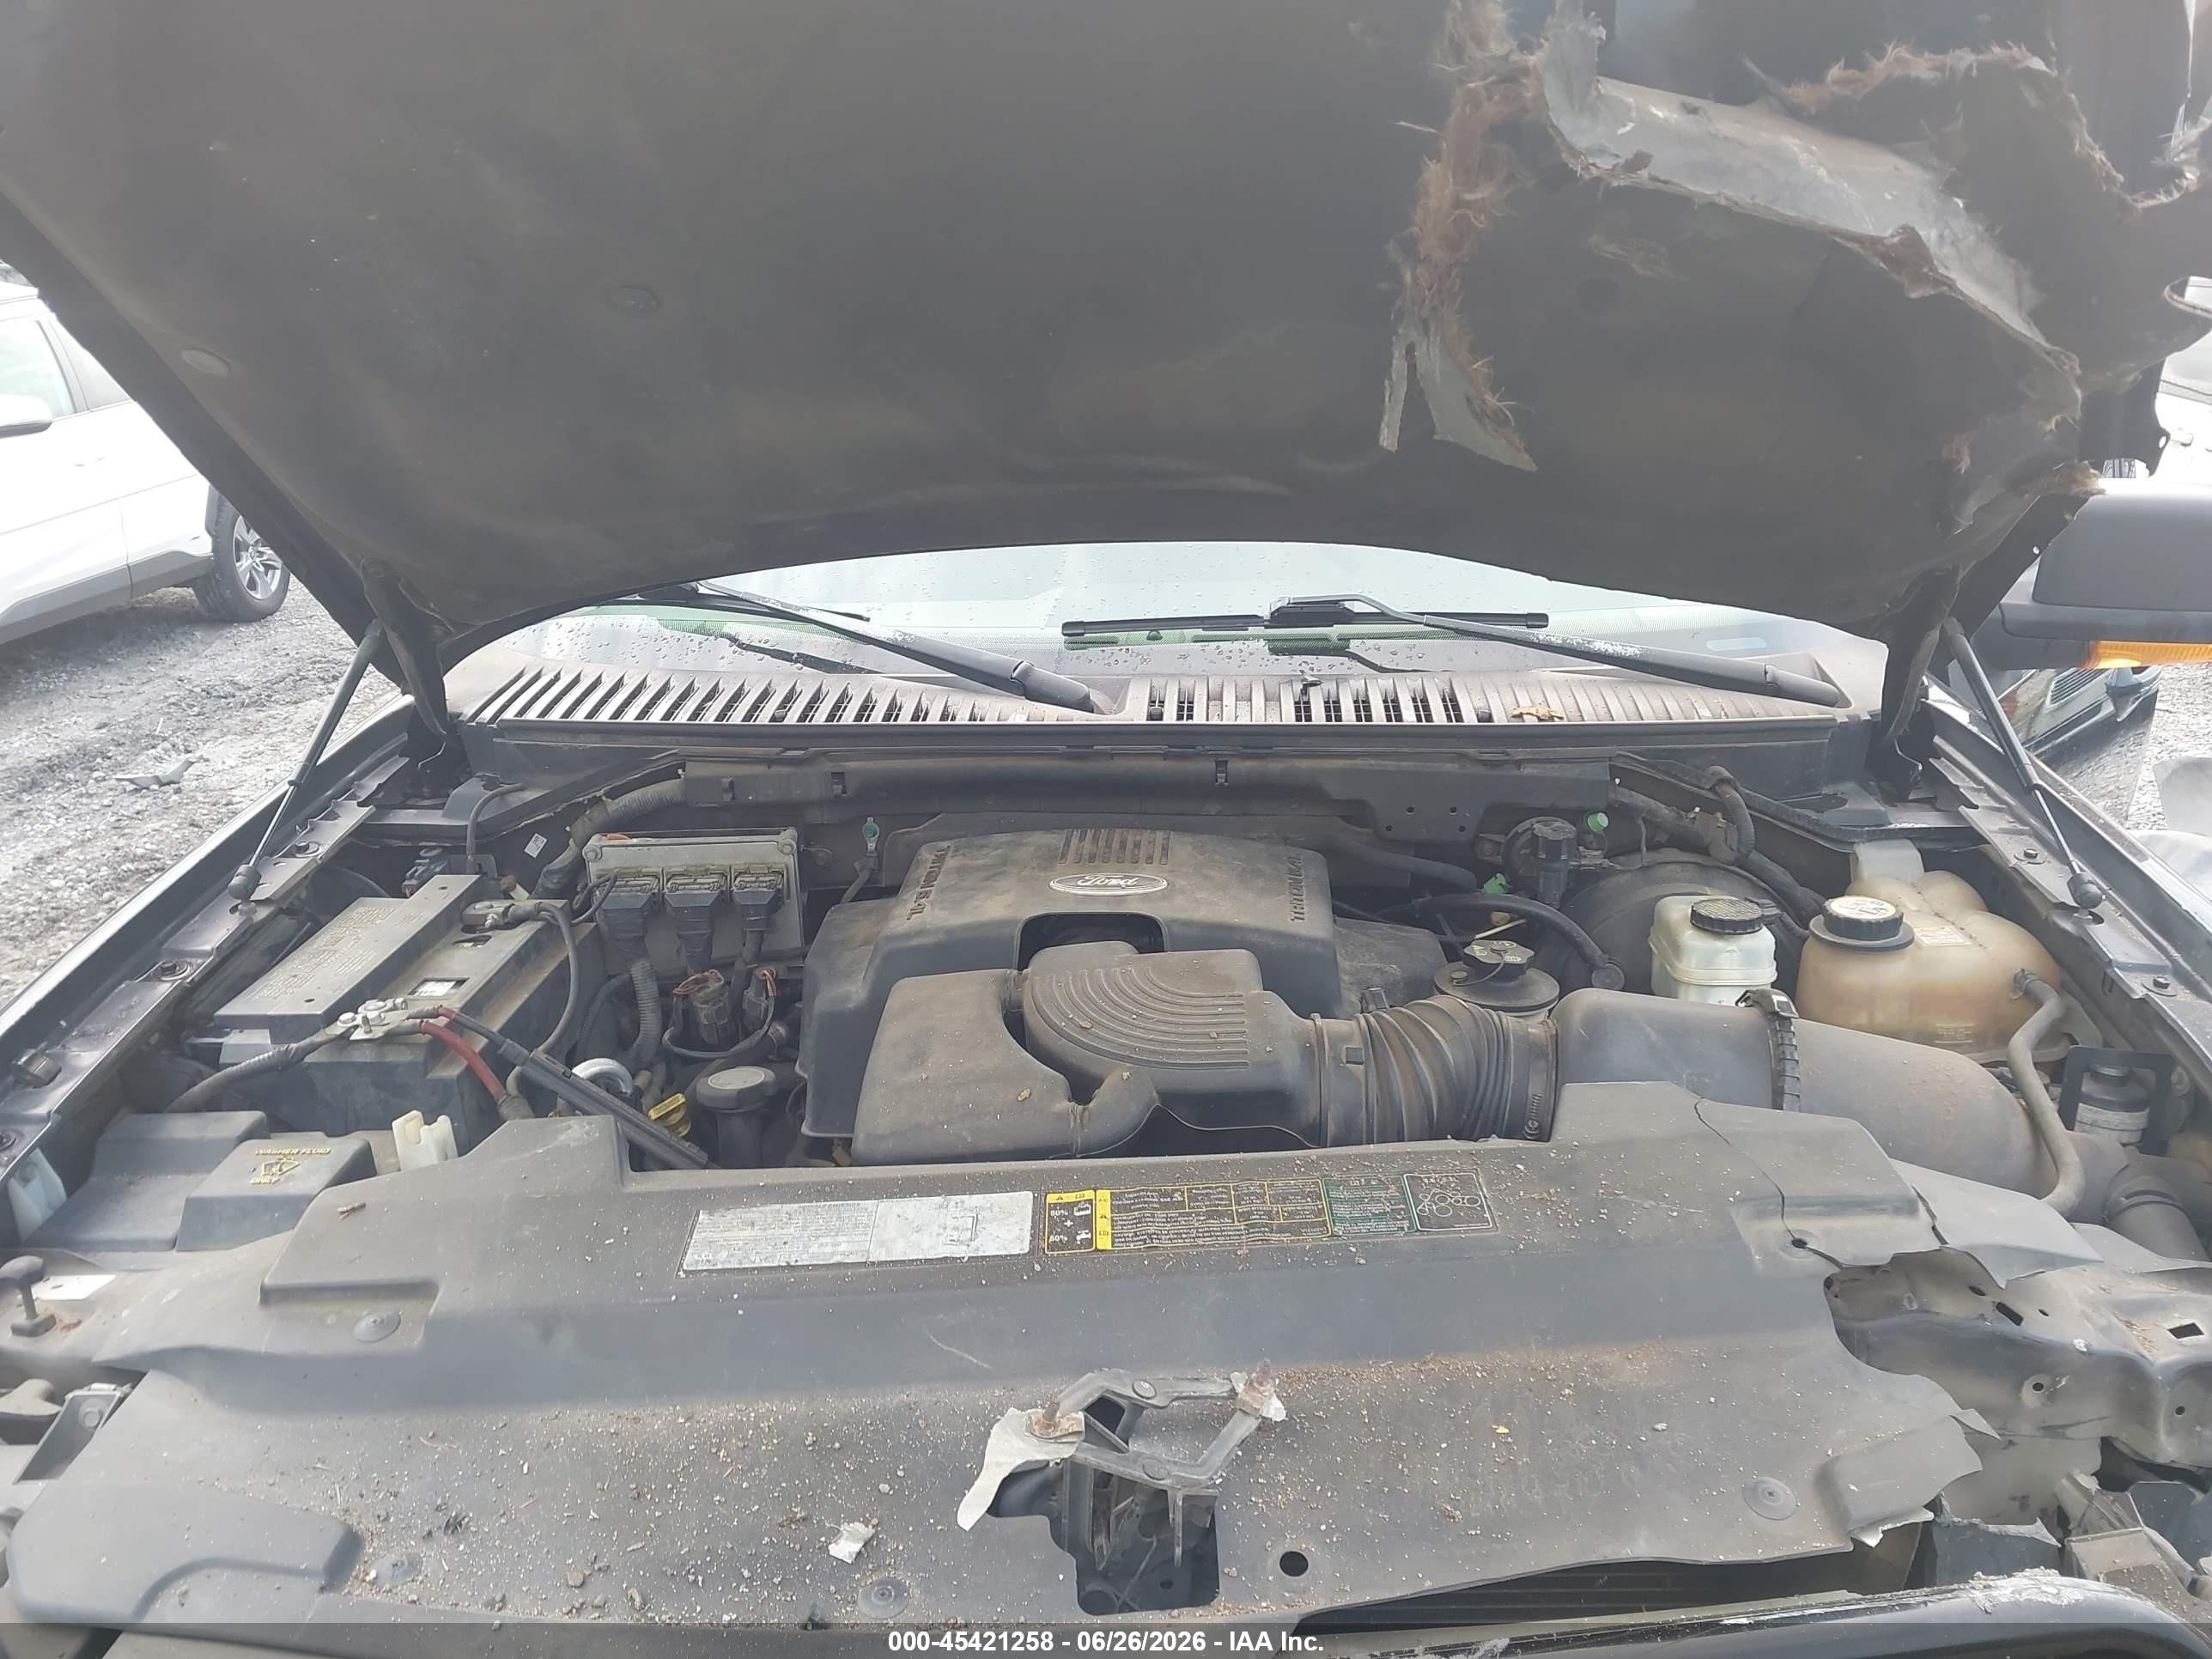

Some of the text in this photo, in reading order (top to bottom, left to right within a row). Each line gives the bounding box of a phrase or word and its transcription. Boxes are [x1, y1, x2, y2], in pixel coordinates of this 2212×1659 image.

[1077, 874, 1140, 889] Ford
[255, 1147, 331, 1156] WASHER FLUID
[249, 1176, 281, 1185] ONLY
